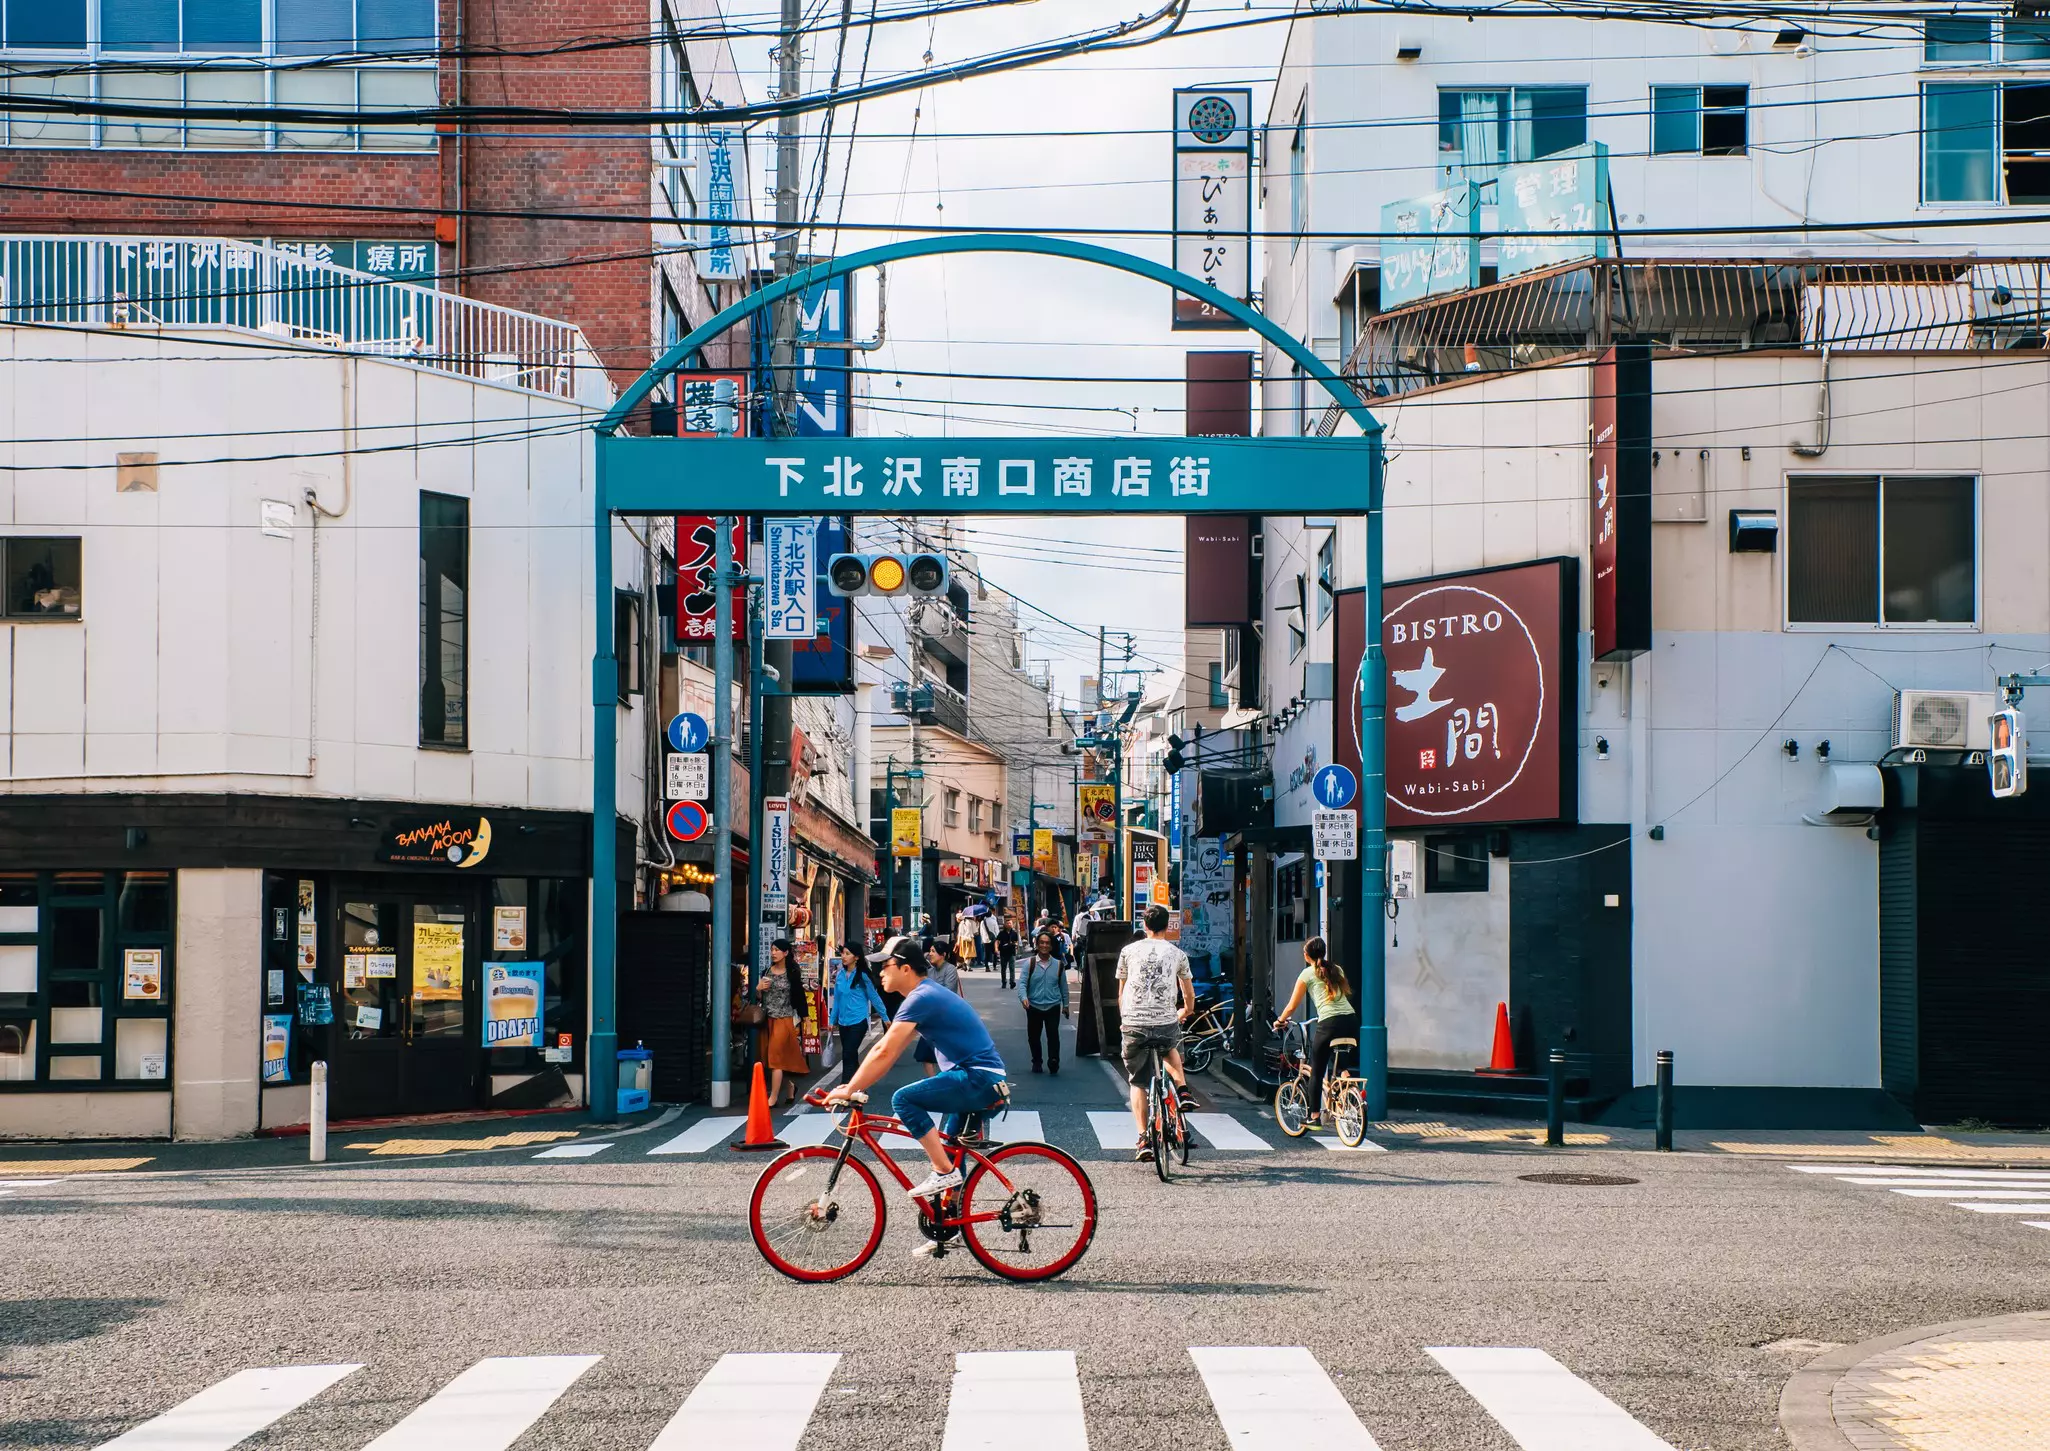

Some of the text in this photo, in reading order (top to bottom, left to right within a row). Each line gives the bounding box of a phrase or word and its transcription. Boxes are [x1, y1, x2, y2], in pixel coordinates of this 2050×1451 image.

[765, 456, 1210, 497] 下北沢南口商店街
[771, 526, 782, 630] Shimokitazawa Sta.
[784, 525, 806, 632] 下北沢駅入口
[1392, 610, 1503, 643] BISTRO
[1405, 779, 1486, 796] Wabi-Sabi
[395, 820, 452, 847] BANANA
[430, 828, 472, 855] MOON
[770, 816, 782, 891] ISUZUYA
[487, 1017, 540, 1043] DRAFT!
